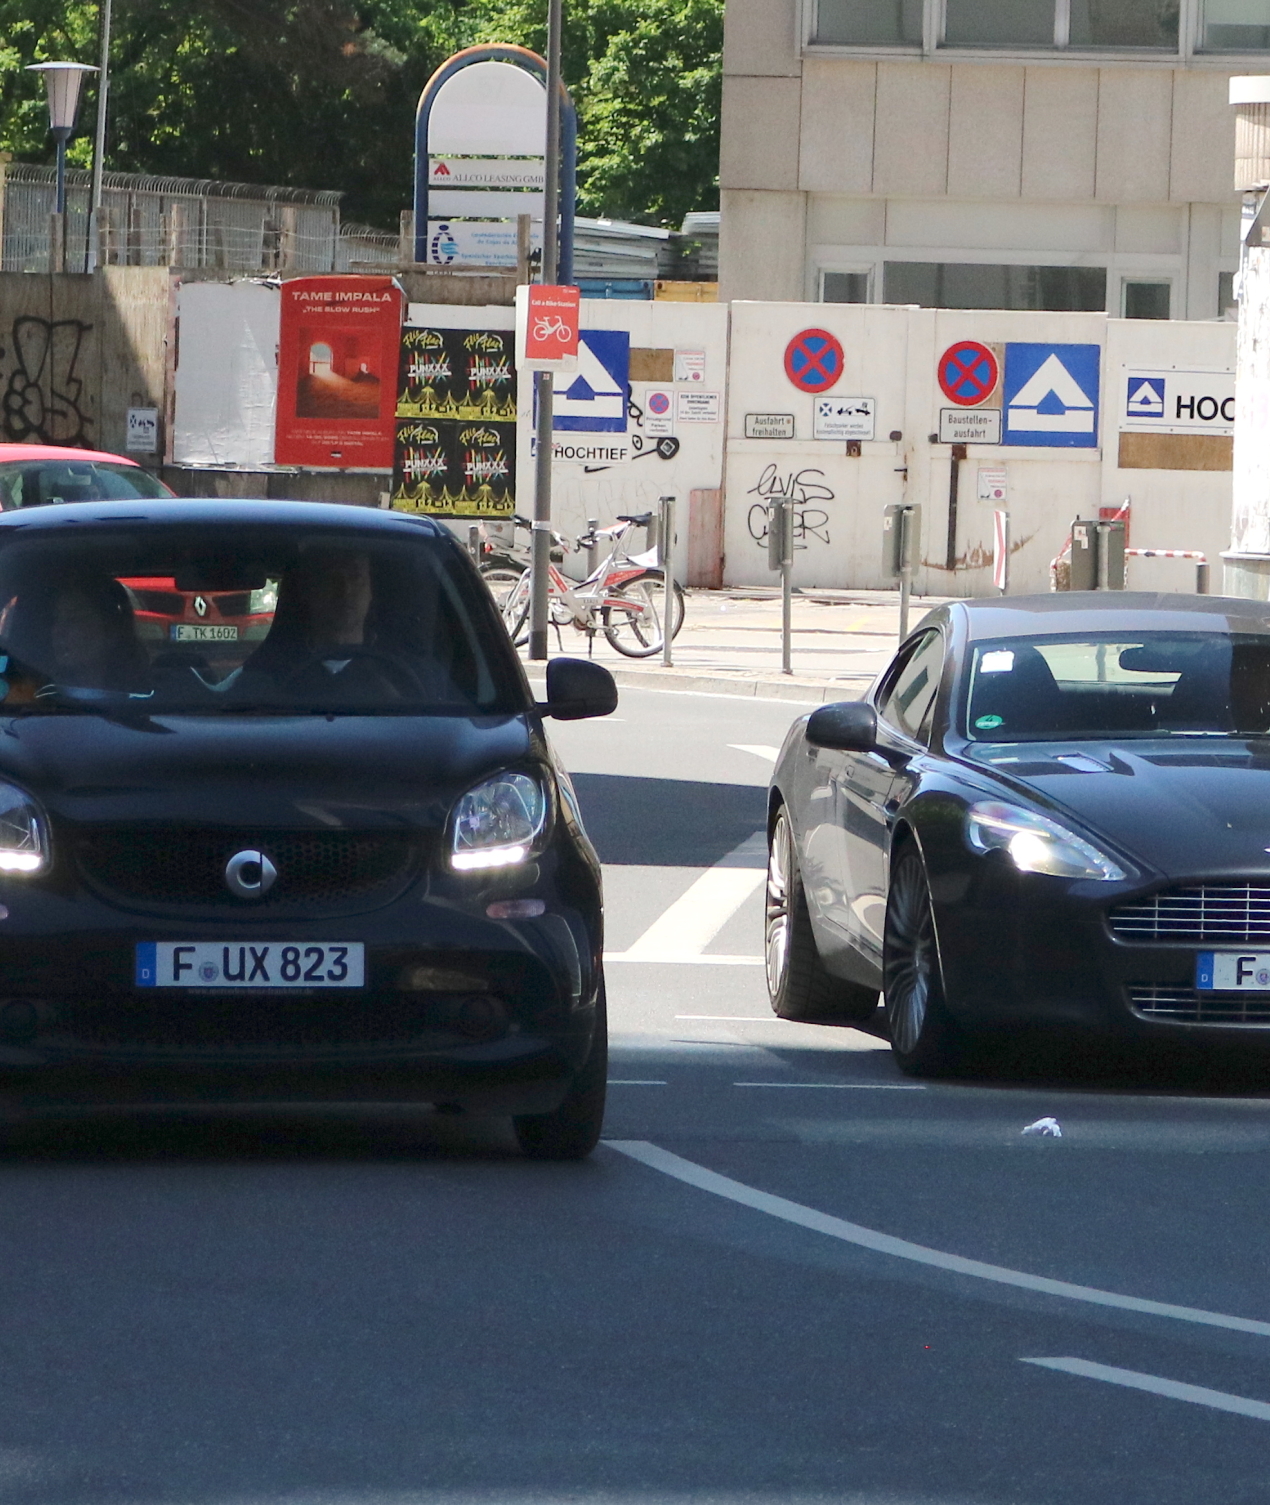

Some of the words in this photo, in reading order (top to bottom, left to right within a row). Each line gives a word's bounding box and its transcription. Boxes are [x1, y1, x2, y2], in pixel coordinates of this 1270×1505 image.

[453, 174, 482, 183] ALLCO
[484, 175, 522, 183] LEASING
[292, 292, 332, 301] TAME
[336, 292, 392, 302] IMPALA
[754, 416, 785, 425] Ausfahrt
[948, 414, 992, 424] Baustellen-
[752, 427, 786, 436] freihalten
[954, 429, 986, 438] ausfahrt
[554, 446, 627, 460] HOCHTIEF
[193, 627, 207, 639] TK
[210, 627, 236, 639] 1602
[141, 969, 149, 979] D
[173, 946, 196, 981] F
[222, 946, 270, 982] UX
[280, 946, 347, 982] 823
[1236, 956, 1256, 985] F
